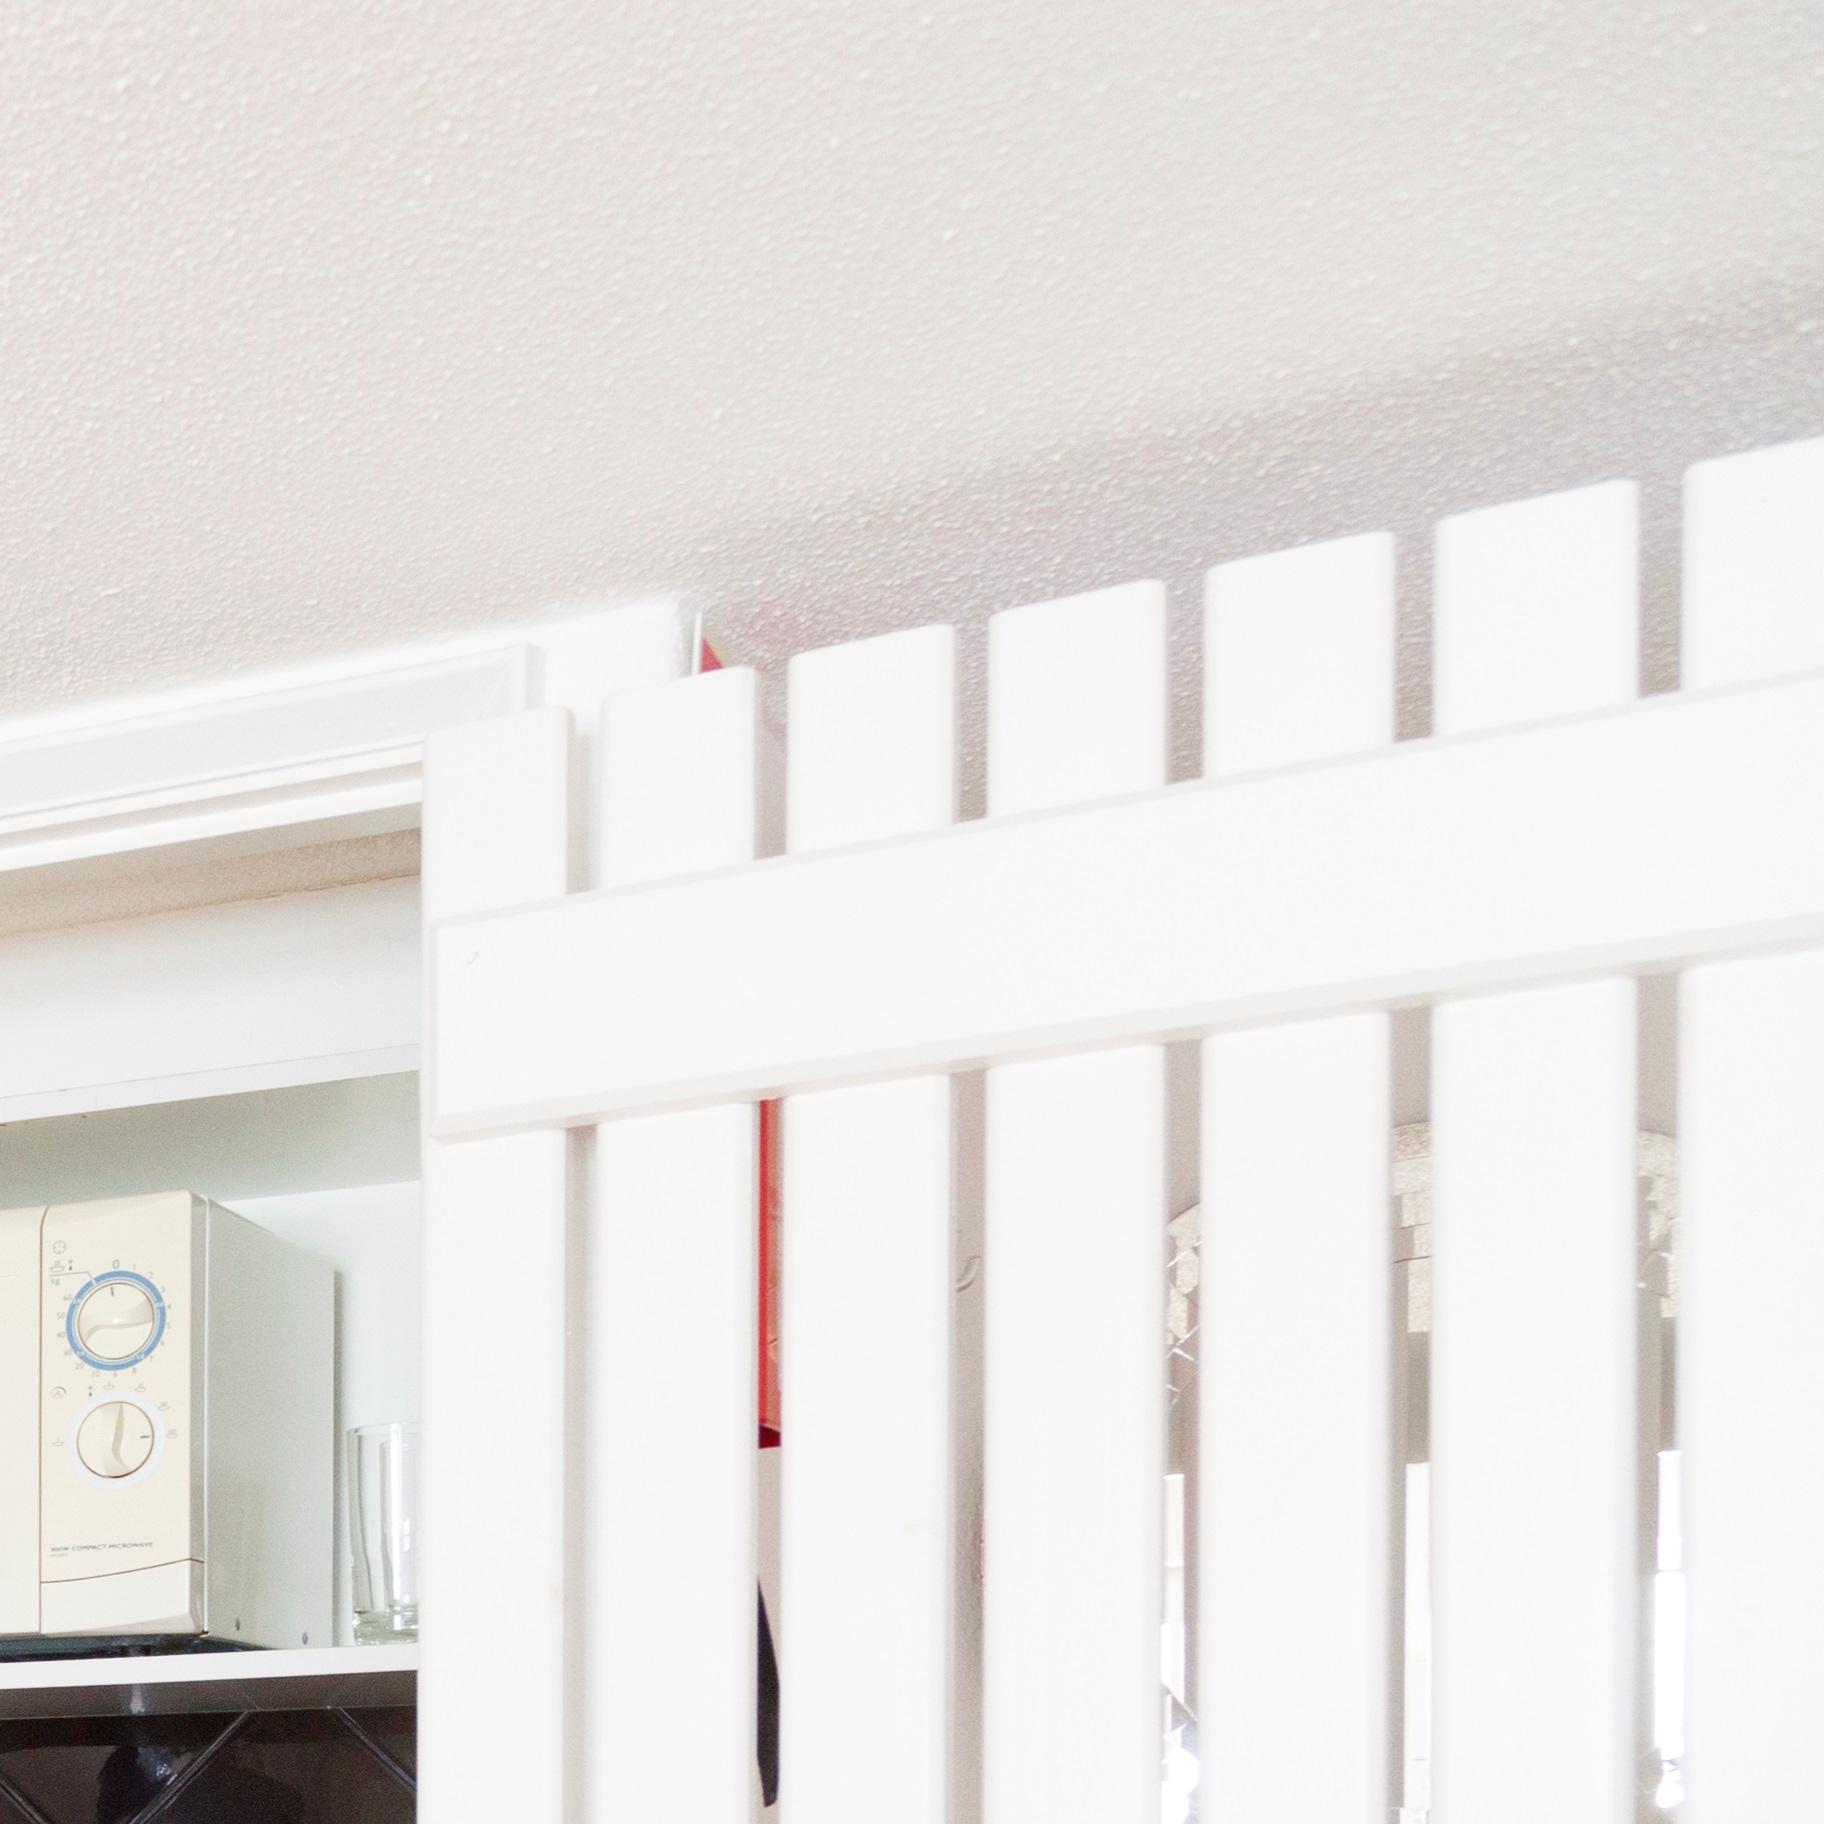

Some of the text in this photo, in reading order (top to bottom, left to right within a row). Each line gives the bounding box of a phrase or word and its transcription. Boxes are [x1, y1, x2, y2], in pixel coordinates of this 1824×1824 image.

[112, 1259, 119, 1269] 0
[71, 1543, 106, 1551] COMPACT
[108, 1541, 153, 1549] MICROWAVE
